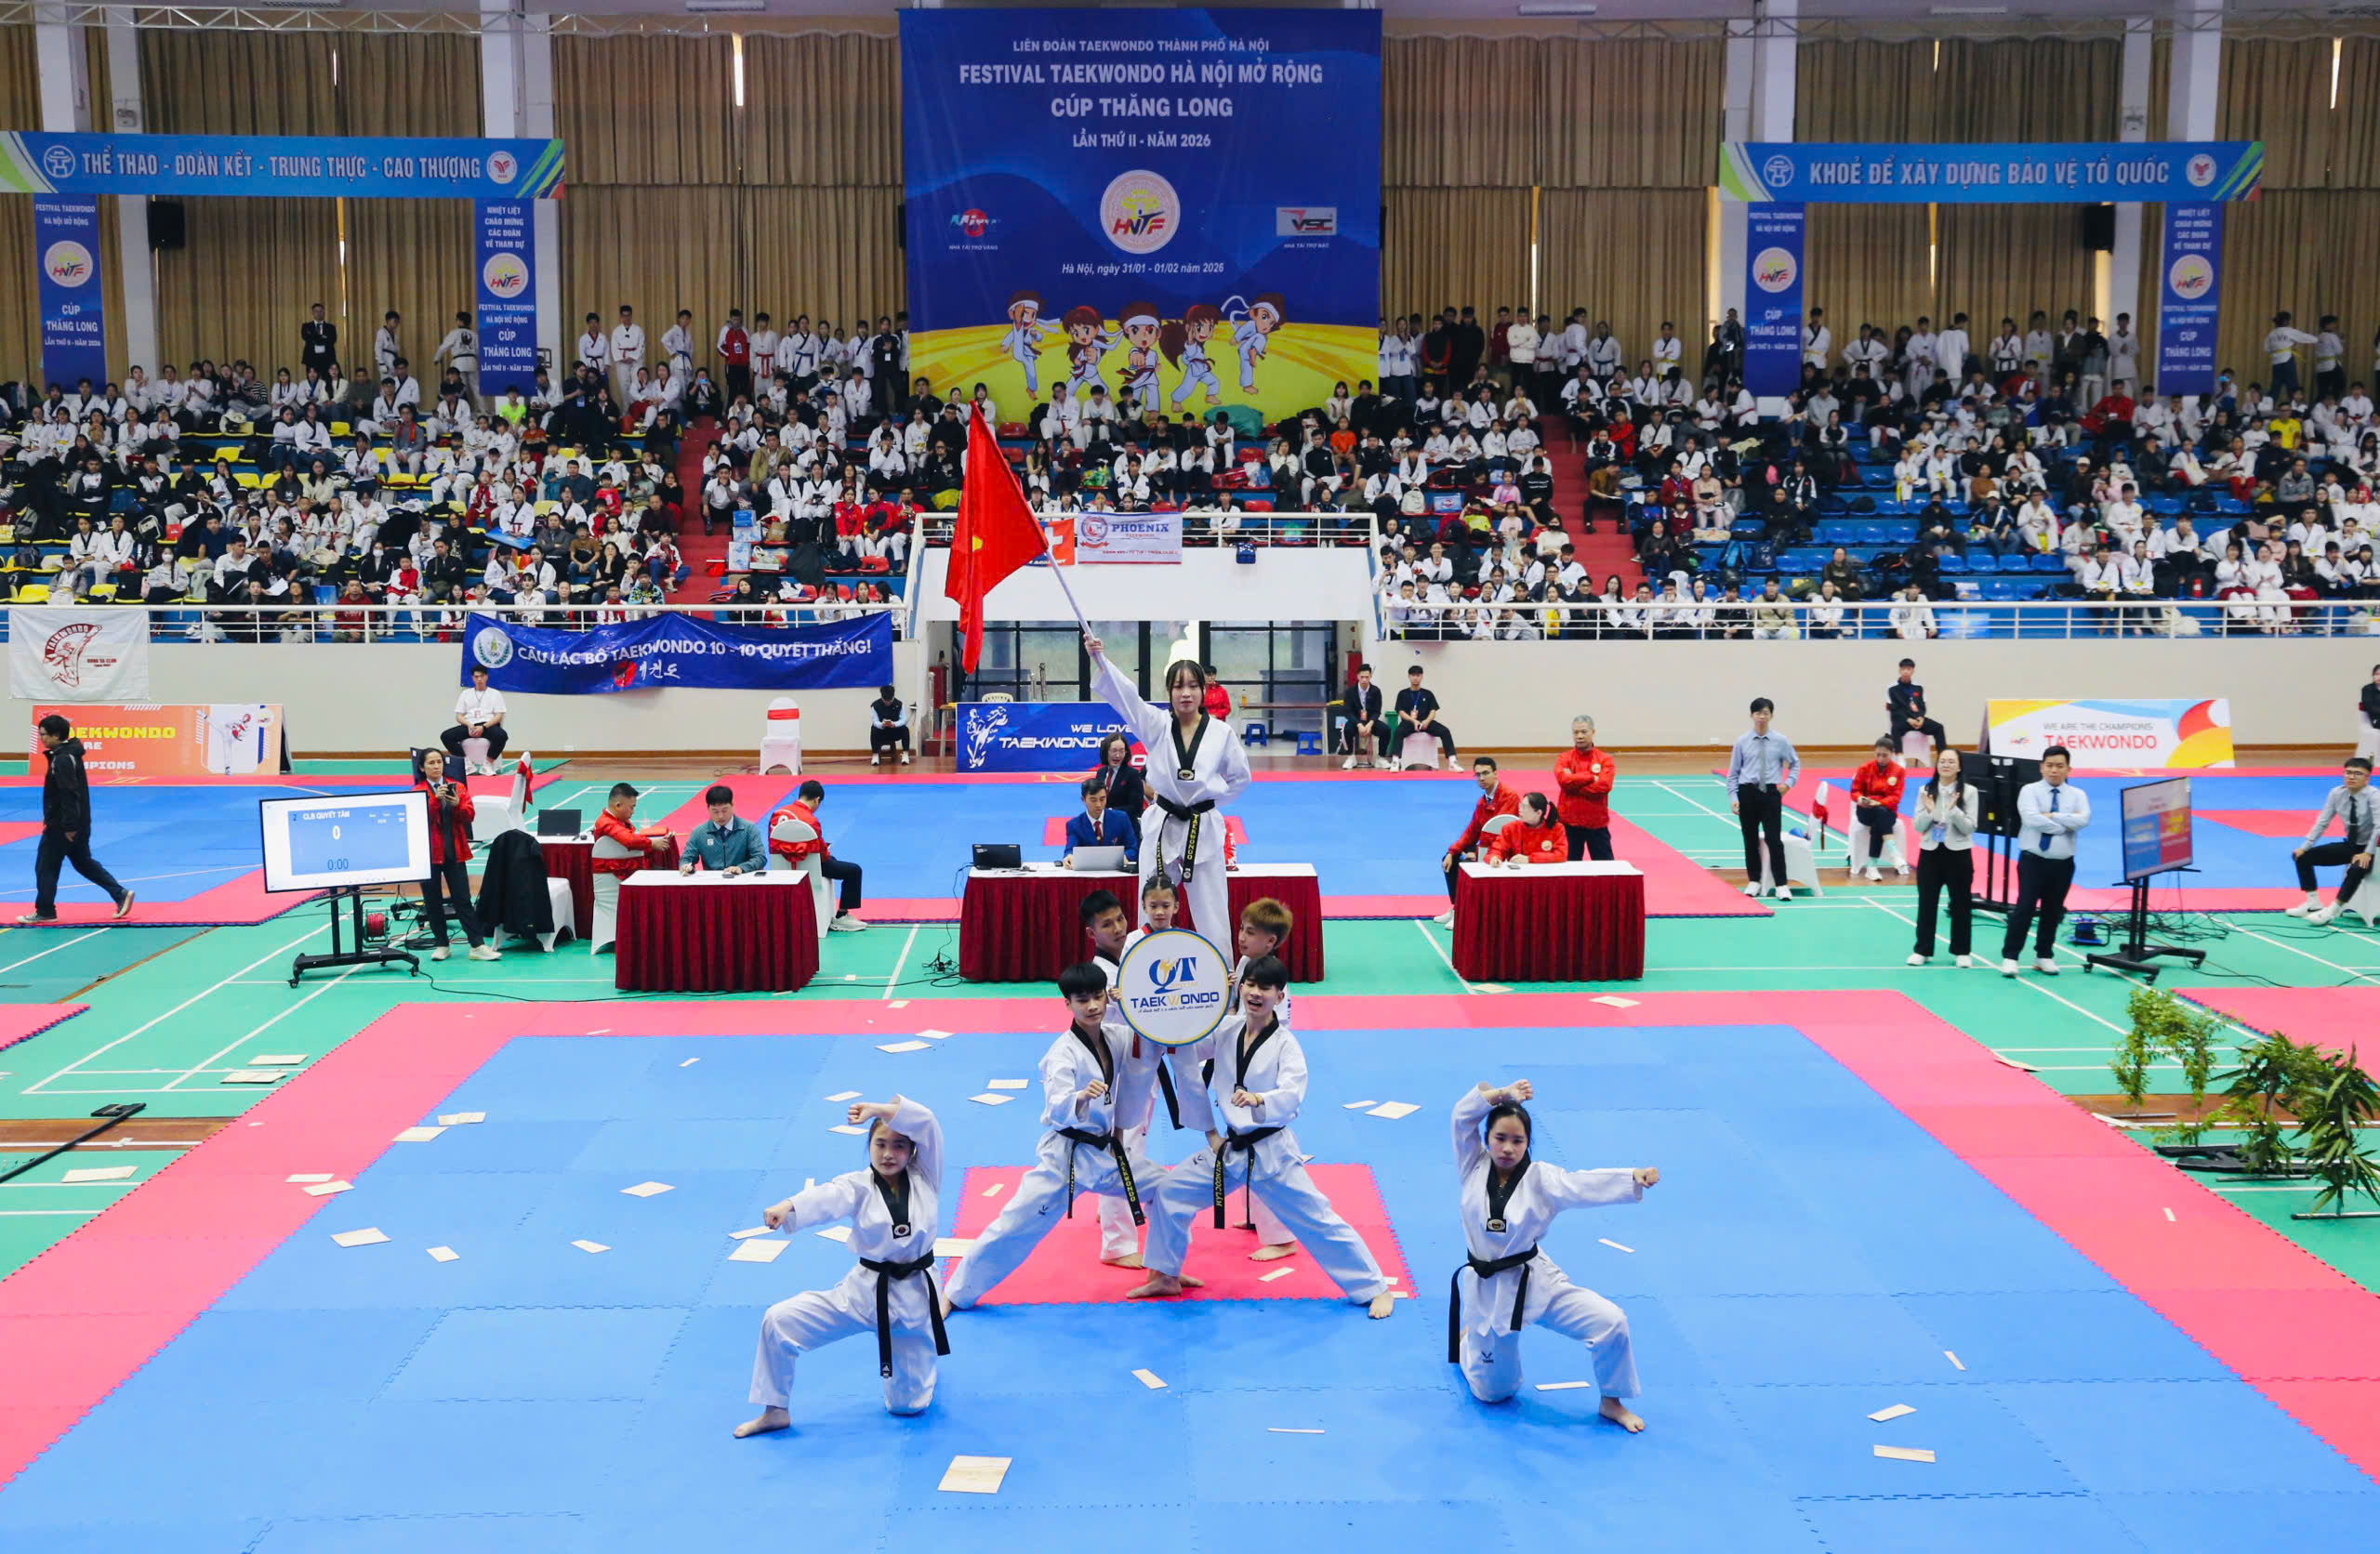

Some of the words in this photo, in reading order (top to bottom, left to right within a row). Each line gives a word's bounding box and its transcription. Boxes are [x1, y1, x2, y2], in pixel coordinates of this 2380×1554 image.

[1013, 38, 1039, 51] LIÊN
[1043, 38, 1076, 51] ĐOÀN
[1079, 41, 1154, 51] TAEKWONDO
[1157, 38, 1197, 51] THÀNH
[1201, 36, 1226, 51] PHỐ
[1229, 38, 1245, 51] HÀ
[1249, 38, 1269, 54] NỘI
[959, 65, 1045, 84] FESTIVAL
[1051, 64, 1165, 83] TAEKWONDO
[1171, 59, 1196, 83] HÀ
[1201, 59, 1233, 87] NỘI
[1238, 57, 1267, 83] MỞ
[1272, 59, 1323, 87] RỘNG
[1051, 93, 1093, 117] CÚP
[1099, 93, 1170, 117] THĂNG
[1177, 98, 1233, 117] LONG
[1073, 127, 1097, 147] LẦN
[1101, 130, 1125, 147] THỨ
[1129, 134, 1136, 147] II
[1147, 131, 1177, 147] NĂM
[1181, 134, 1211, 147] 2026
[82, 145, 112, 175] THỂ
[117, 153, 158, 176] THAO
[175, 151, 218, 177] ĐOÀN
[224, 148, 252, 177] KẾT
[270, 156, 321, 178] TRUNG
[327, 156, 365, 182] THỰC
[382, 157, 414, 178] CAO
[419, 156, 481, 183] THƯỢNG
[1810, 156, 1860, 184] KHOẺ
[1869, 153, 1896, 184] ĐỂ
[1900, 158, 1939, 184] XÂY
[1946, 161, 2001, 190] DỰNG
[2008, 156, 2046, 184] BẢO
[2054, 158, 2077, 189] VỆ
[2084, 152, 2110, 184] TỔ
[2116, 154, 2170, 185] QUỐC
[1062, 264, 1075, 273] Hà
[1077, 264, 1095, 276] Nội,
[1097, 264, 1120, 276] ngày
[1122, 263, 1146, 274] 31/01
[1154, 263, 1179, 273] 01/02
[1181, 264, 1200, 273] năm
[1203, 262, 1224, 273] 2026
[479, 303, 502, 311] FESTIVAL
[498, 328, 516, 341] CÚP
[483, 345, 509, 358] THĂNG
[511, 347, 532, 358] LONG
[1112, 523, 1170, 533] PHOENIX
[46, 624, 89, 652] TAEKWONDO
[550, 652, 582, 669] LẠC
[585, 648, 608, 667] BỘ
[612, 639, 706, 662] TAEKWONDO
[710, 641, 726, 654] 10
[740, 644, 755, 656] 10
[759, 641, 810, 660] QUYẾT
[68, 727, 176, 739] AEKWONDO
[1071, 724, 1093, 733] WE
[2099, 722, 2154, 731] CHAMPIONS
[2043, 734, 2158, 749] TAEKWONDO
[332, 825, 340, 840] 0
[1187, 813, 1199, 861] TAEKWONDO
[327, 858, 350, 871] 0:00
[1130, 992, 1220, 1008] TAEKWONDO
[1117, 1155, 1136, 1202] TAEKWONDO
